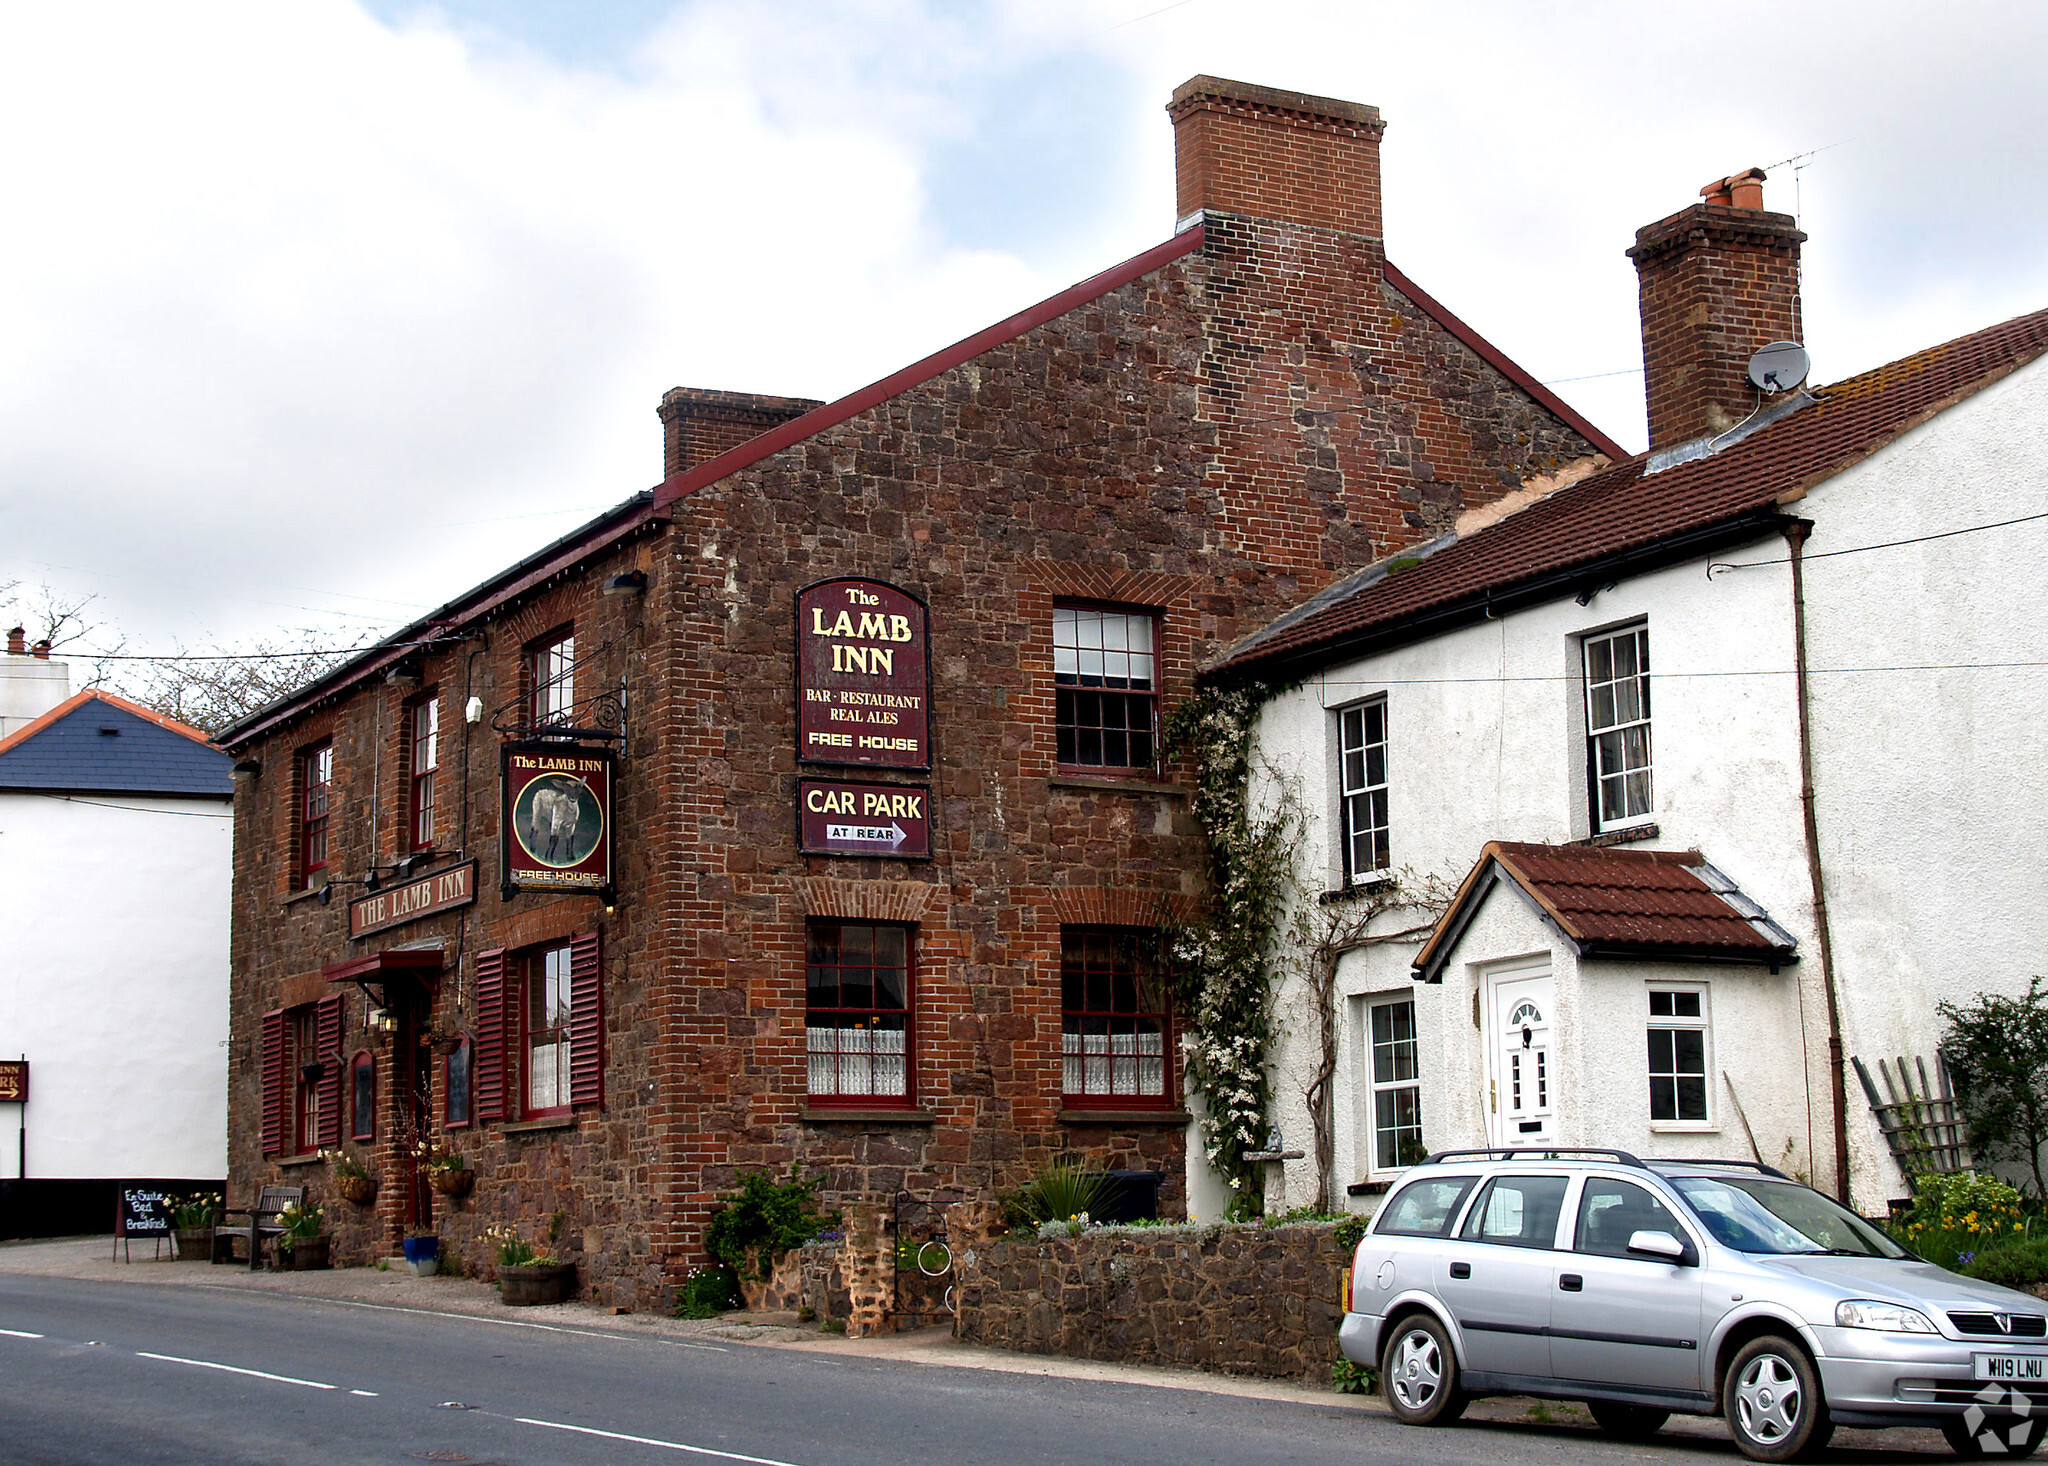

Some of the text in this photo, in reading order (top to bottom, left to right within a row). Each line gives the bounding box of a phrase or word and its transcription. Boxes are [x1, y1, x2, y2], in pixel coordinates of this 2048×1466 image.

[845, 588, 879, 605] The
[812, 608, 912, 642] LAMB
[832, 644, 893, 676] INN
[806, 689, 921, 709] BAR RESTAURANT
[830, 708, 898, 725] REAL ALES
[808, 732, 918, 751] FREE HOUSE
[513, 755, 601, 772] The LAMB INN
[807, 790, 922, 819] CAR PARK
[832, 828, 894, 840] AT REAR
[519, 870, 599, 882] FREE HOUSE
[359, 870, 465, 927] THE LAMB INN
[126, 1217, 168, 1230] Breakfast
[2017, 1359, 2042, 1378] LNU
